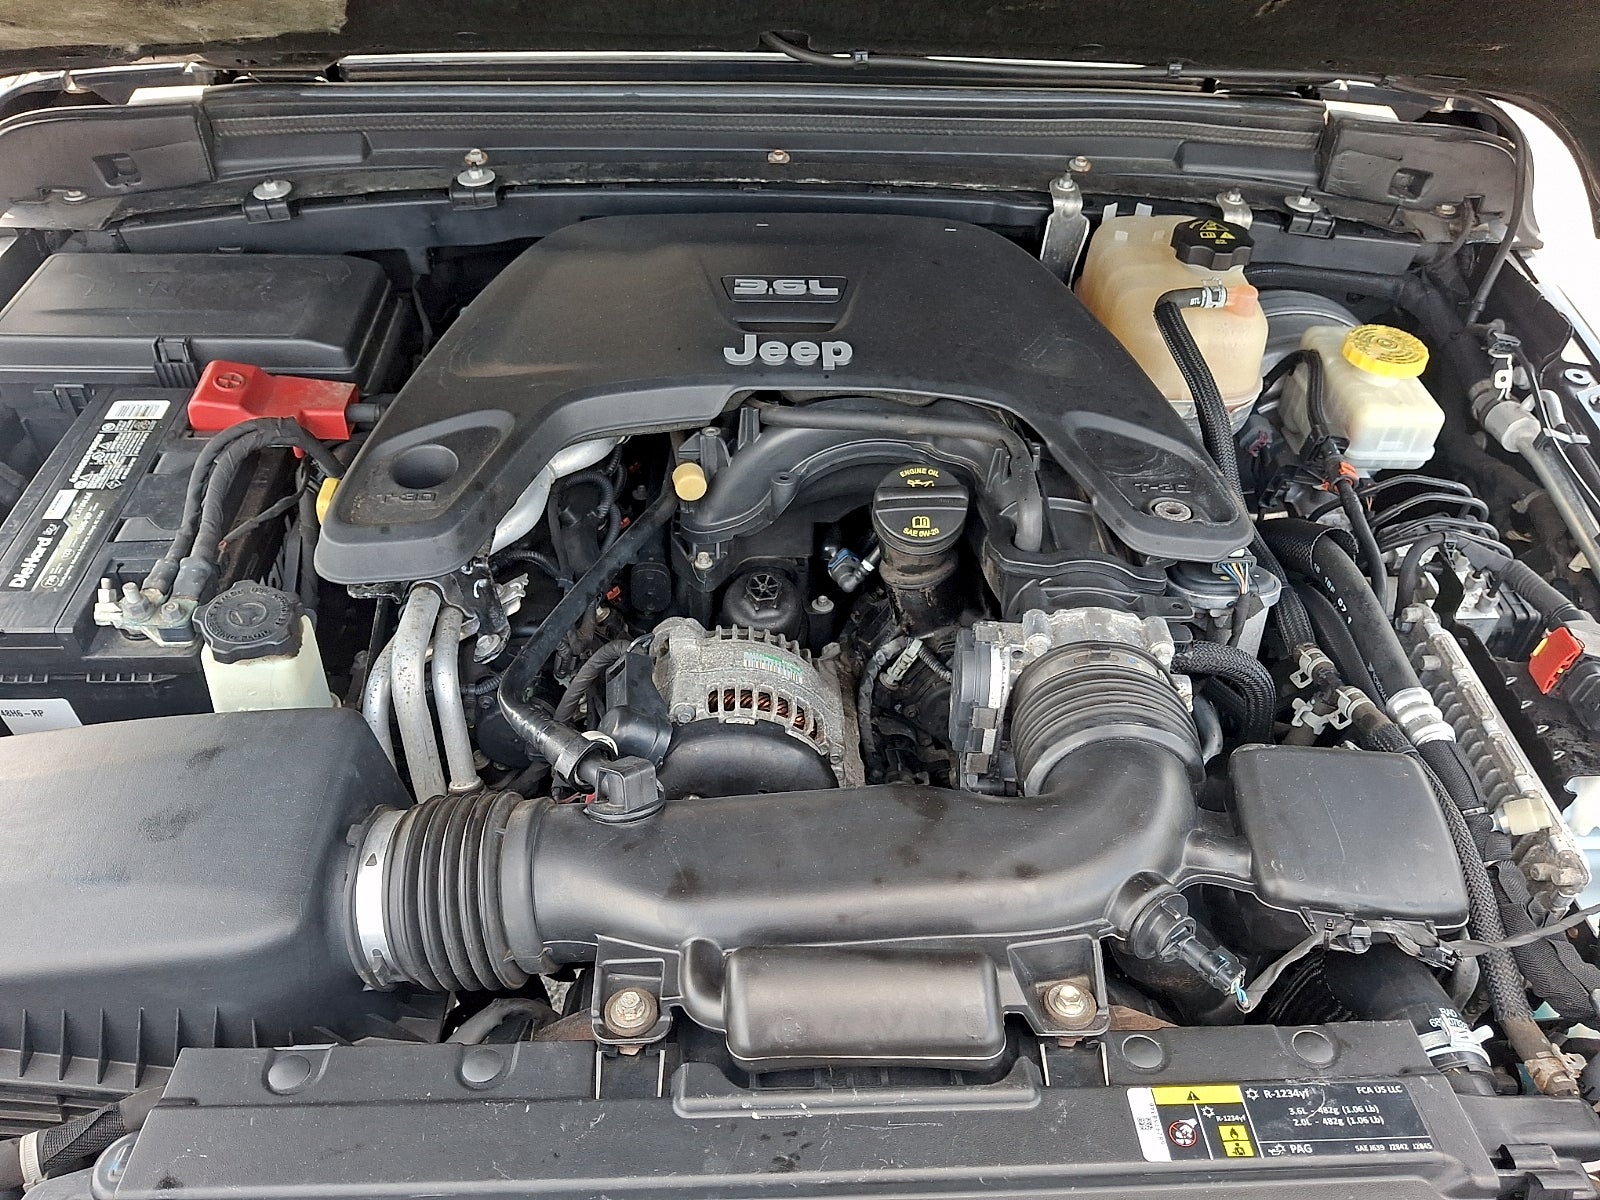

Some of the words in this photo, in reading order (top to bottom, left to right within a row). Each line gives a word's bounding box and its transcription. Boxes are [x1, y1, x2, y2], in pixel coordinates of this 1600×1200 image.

[734, 279, 839, 295] 3.6L
[723, 334, 852, 370] Jeep
[899, 468, 927, 478] ENGINE
[928, 468, 940, 478] OIL
[903, 527, 918, 537] SAE
[918, 527, 940, 538] 0W-20
[8, 536, 54, 589] DieHard
[1439, 1007, 1458, 1018] RAD
[1263, 1088, 1309, 1100] R-1234yf
[1356, 1086, 1374, 1095] FCA
[1374, 1086, 1387, 1094] US
[1387, 1085, 1403, 1093] LLC
[1288, 1107, 1308, 1115] 3.6L
[1318, 1106, 1340, 1115] 482g
[1342, 1105, 1364, 1115] (1.06
[1365, 1104, 1379, 1114] Lb)
[1216, 1114, 1246, 1123] R-1234yf
[1293, 1118, 1312, 1127] 2.0L
[1323, 1118, 1345, 1127] 482g
[1346, 1116, 1369, 1127] (1.06
[1368, 1115, 1384, 1125] Lb)
[1290, 1144, 1313, 1154] PAG
[1355, 1144, 1368, 1152] SAE
